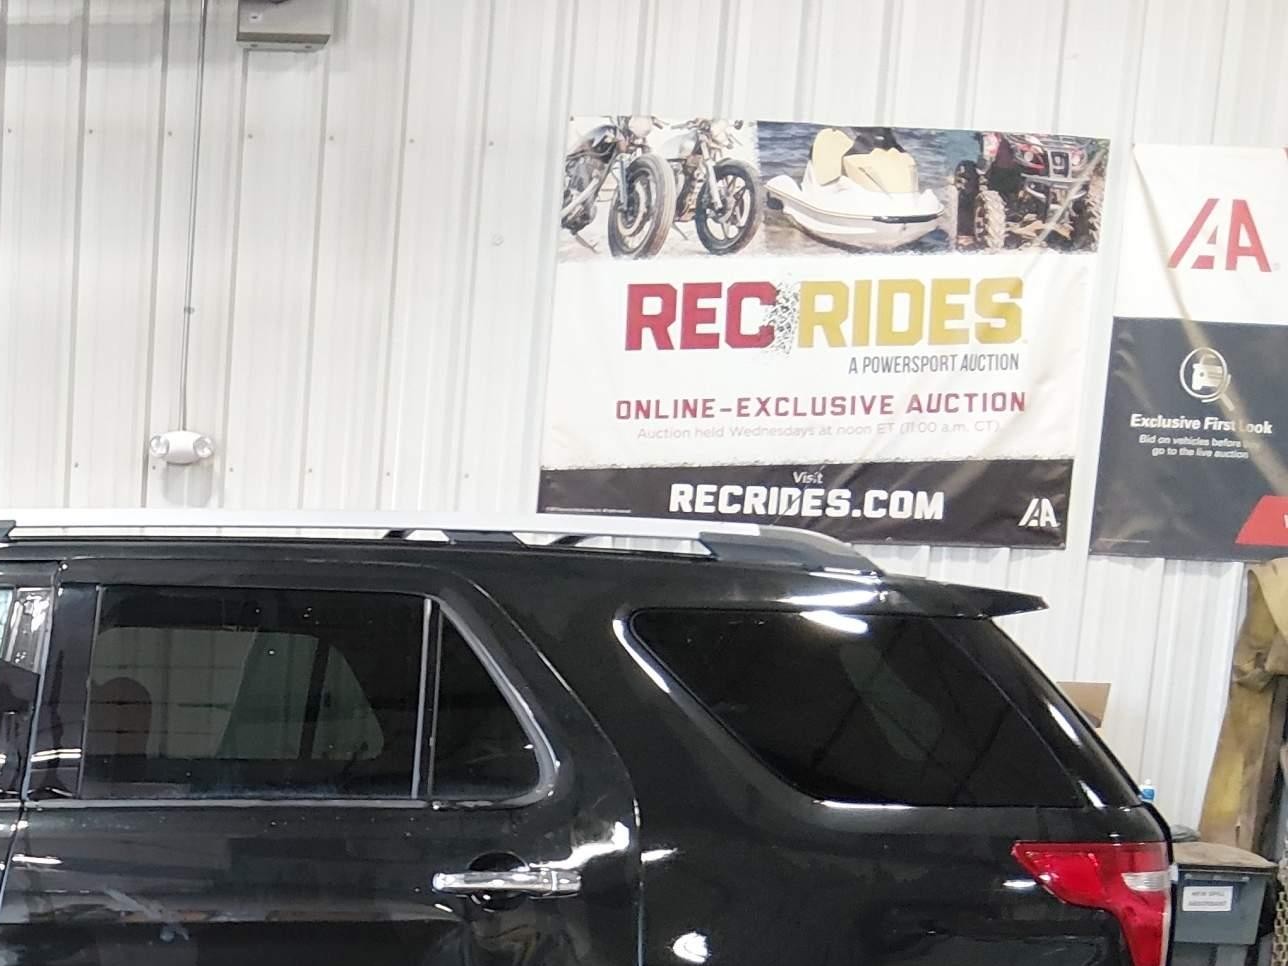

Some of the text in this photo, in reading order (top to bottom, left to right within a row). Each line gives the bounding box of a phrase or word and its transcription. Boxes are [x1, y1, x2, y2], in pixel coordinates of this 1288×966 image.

[625, 277, 1024, 350] REC RIDES
[848, 353, 1020, 374] A POWERSPORT AUCTION
[616, 392, 1026, 419] ONLINE-EXCLUSIVE AUCTION
[637, 427, 690, 439] Auction
[695, 426, 724, 438] held
[819, 426, 833, 436] at
[836, 425, 872, 436] noon
[877, 422, 896, 434] ET
[1130, 413, 1201, 430] Exclusive
[1203, 416, 1236, 432] First
[793, 471, 823, 484] Visit
[669, 484, 944, 521] RECRIDES.COM
